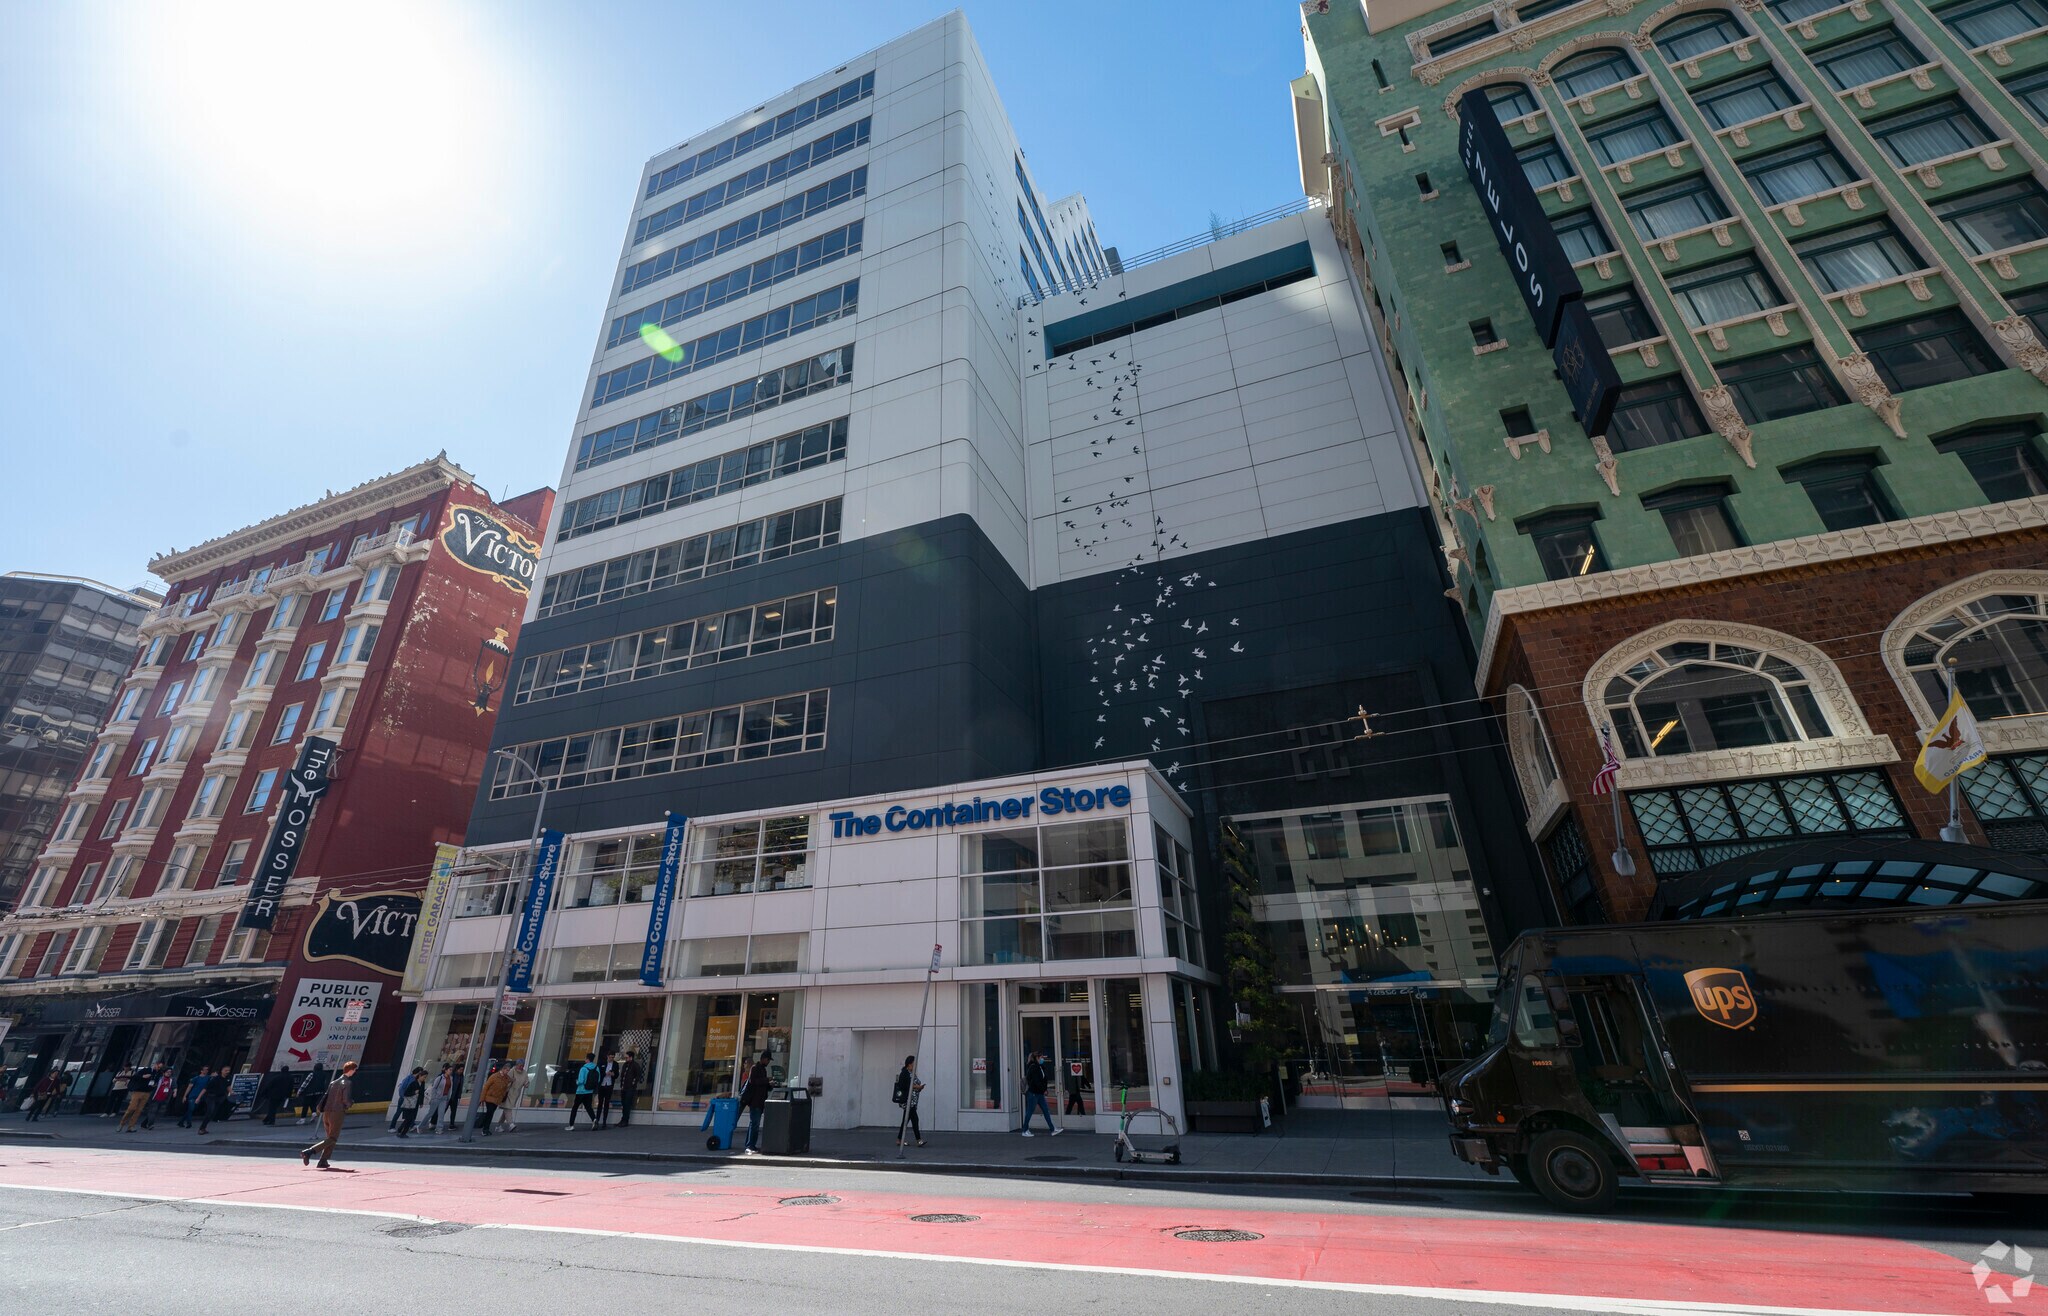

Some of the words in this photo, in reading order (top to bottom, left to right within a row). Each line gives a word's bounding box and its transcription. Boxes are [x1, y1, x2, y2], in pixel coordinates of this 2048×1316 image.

[1465, 121, 1474, 169] HOTEL
[1475, 151, 1543, 307] ZELOS
[474, 515, 489, 529] The
[303, 748, 331, 781] The
[829, 810, 882, 838] The
[884, 795, 1036, 833] Container
[1039, 784, 1132, 815] Store
[665, 827, 680, 867] Store
[418, 930, 434, 965] ENTER
[427, 880, 448, 928] GARAGE
[514, 951, 530, 981] The
[522, 882, 547, 952] Container
[539, 843, 557, 880] Store
[650, 867, 672, 943] Container
[644, 944, 658, 975] The
[309, 983, 370, 996] PUBLIC
[1694, 985, 1752, 1020] ups
[85, 1008, 95, 1018] The
[185, 1005, 205, 1017] The
[299, 1018, 316, 1038] P
